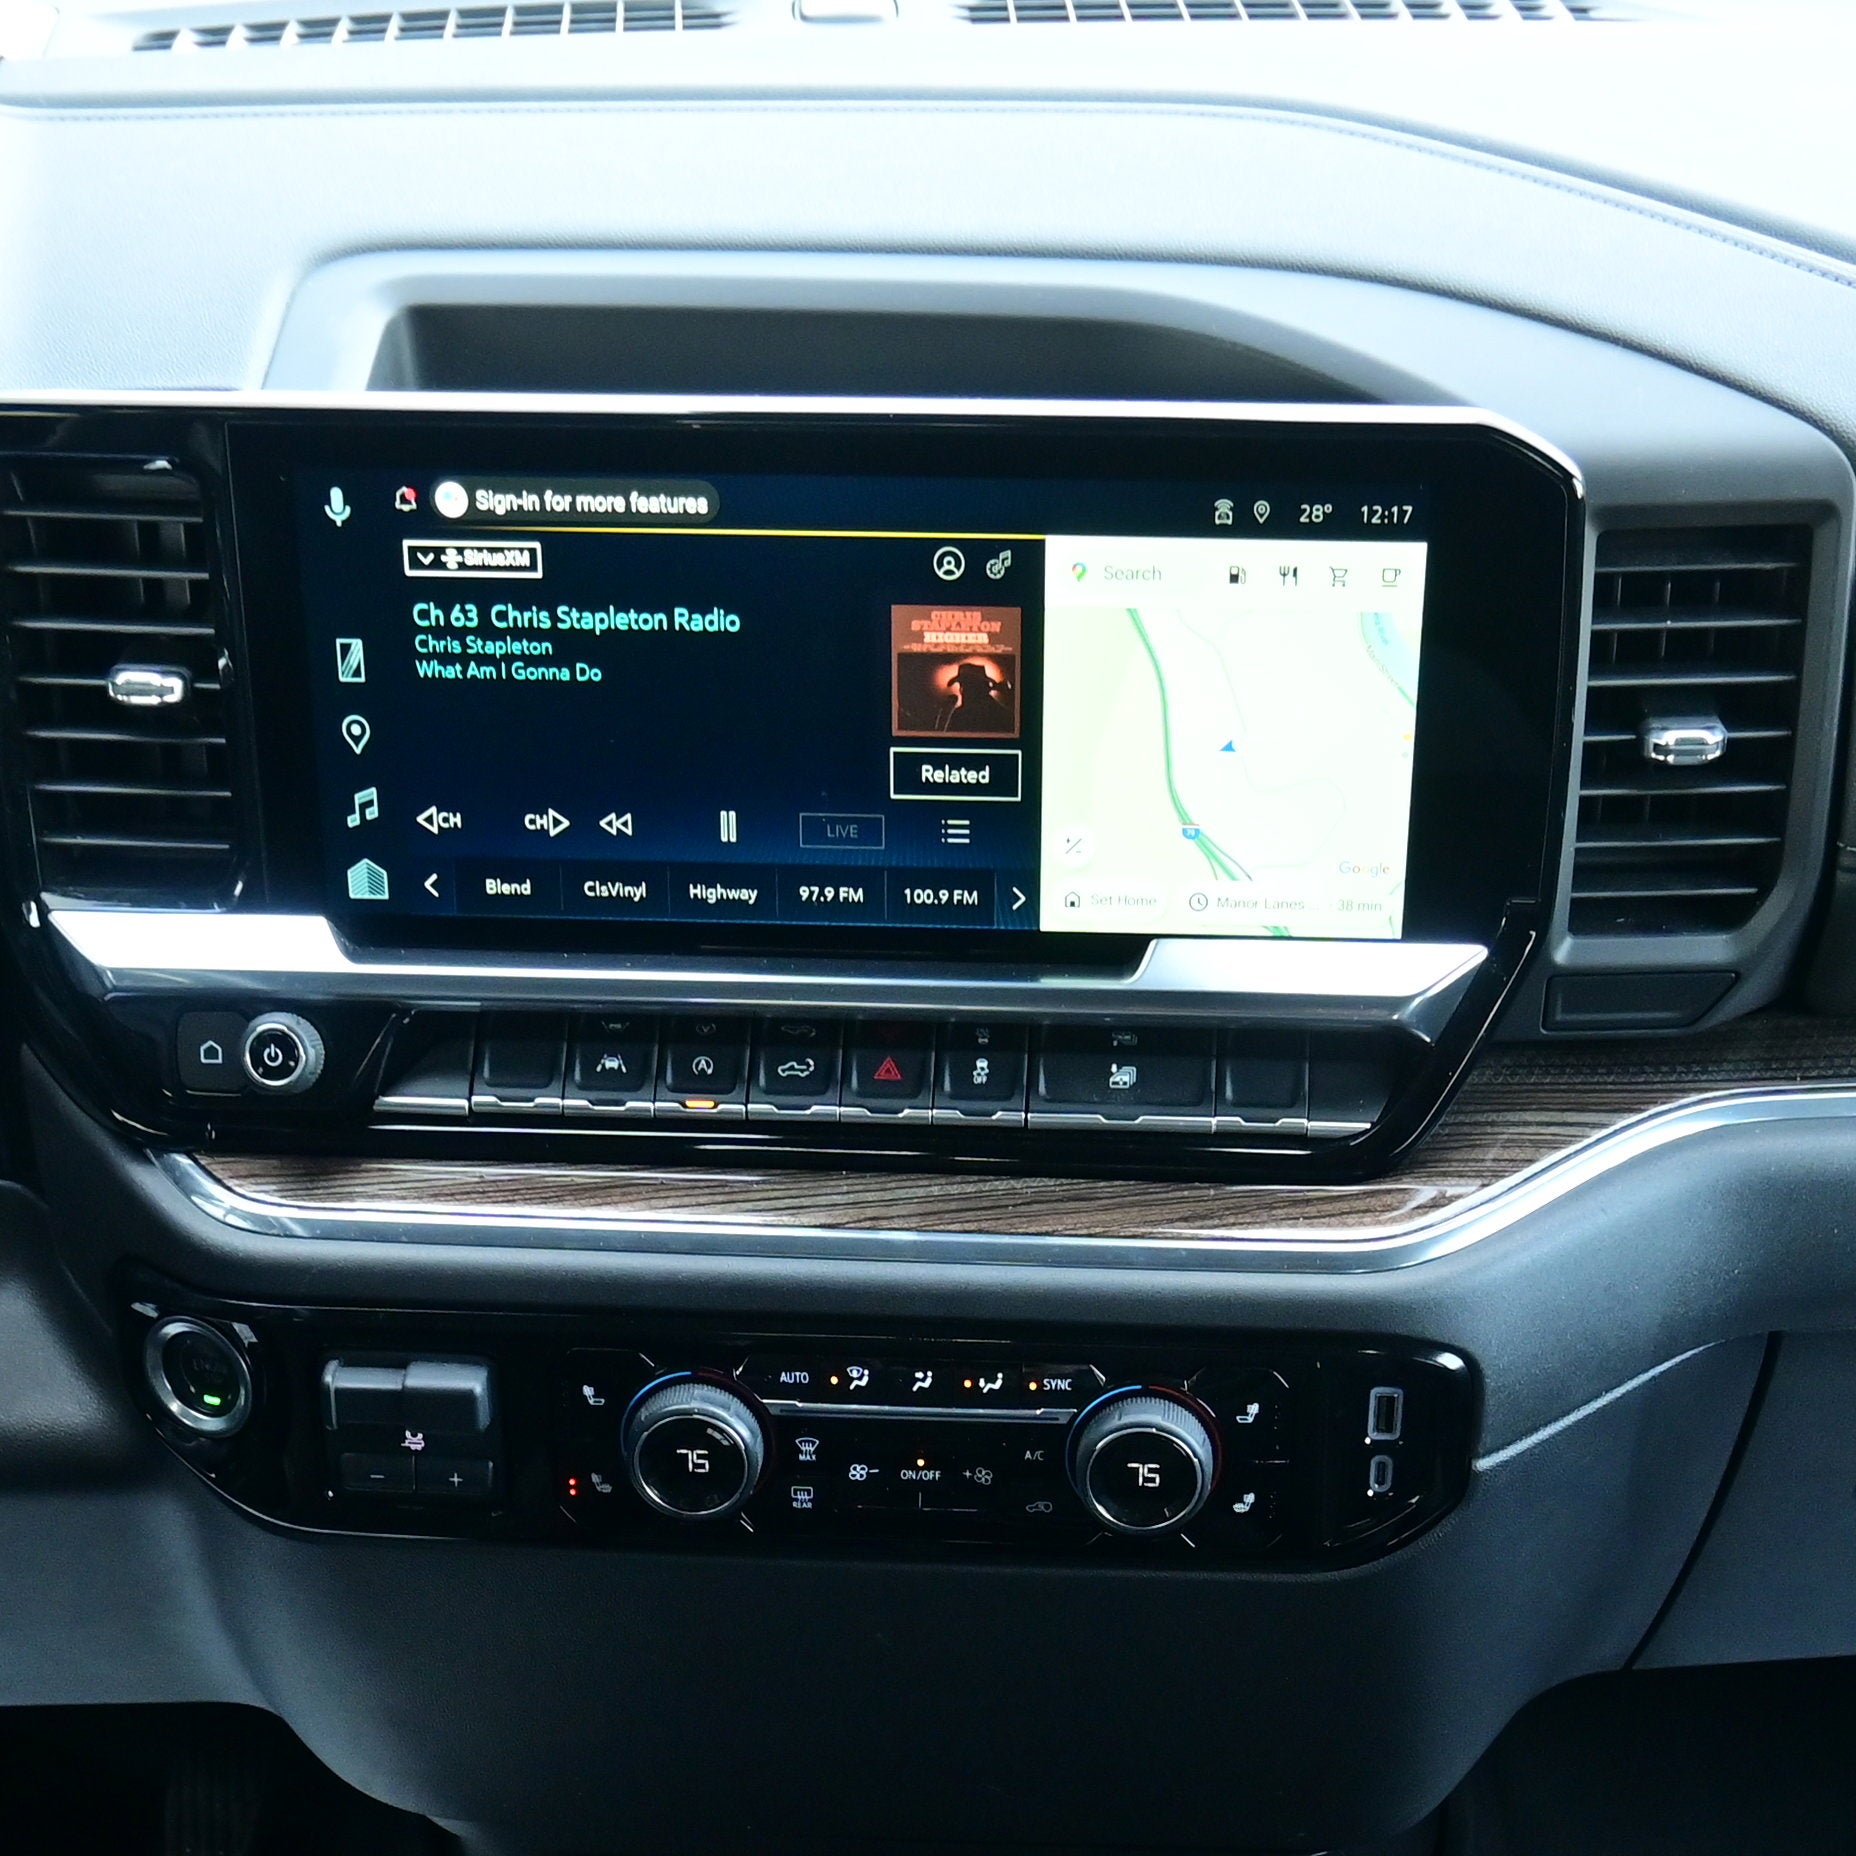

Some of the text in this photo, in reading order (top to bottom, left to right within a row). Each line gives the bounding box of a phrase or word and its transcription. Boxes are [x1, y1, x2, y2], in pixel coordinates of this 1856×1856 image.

[475, 489, 708, 515] Sign-in for more features
[1361, 505, 1413, 524] 12:17
[464, 549, 530, 568] SiriusXM
[1103, 566, 1162, 582] Search
[412, 603, 741, 635] Ch 63 Chris Stapleton Radio
[911, 620, 1001, 632] STAPLETON
[923, 632, 989, 643] HIGHER
[415, 634, 553, 659] Chris Stapleton
[415, 659, 602, 682] What Am I Gonna Do
[921, 764, 990, 784] Related
[438, 812, 462, 830] CH
[524, 814, 548, 831] CH
[827, 823, 859, 839] LIVE
[1338, 861, 1390, 877] Google
[485, 878, 532, 896] Blend
[583, 881, 648, 902] ClsVinyl
[689, 884, 759, 904] Highway
[799, 886, 864, 903] 97.9 FM
[903, 888, 979, 906] 100.9 FM
[1090, 894, 1157, 908] Set Home
[1216, 895, 1305, 911] Manor Lanes
[1337, 899, 1382, 912] 38 min
[779, 1372, 809, 1385] AUTO
[1043, 1379, 1072, 1391] SYNC
[676, 1448, 710, 1473] 75
[798, 1453, 817, 1462] MAX
[1024, 1450, 1044, 1461] A/C
[900, 1470, 941, 1481] ON/OFF
[1126, 1462, 1161, 1489] 75
[792, 1500, 813, 1509] REAR
